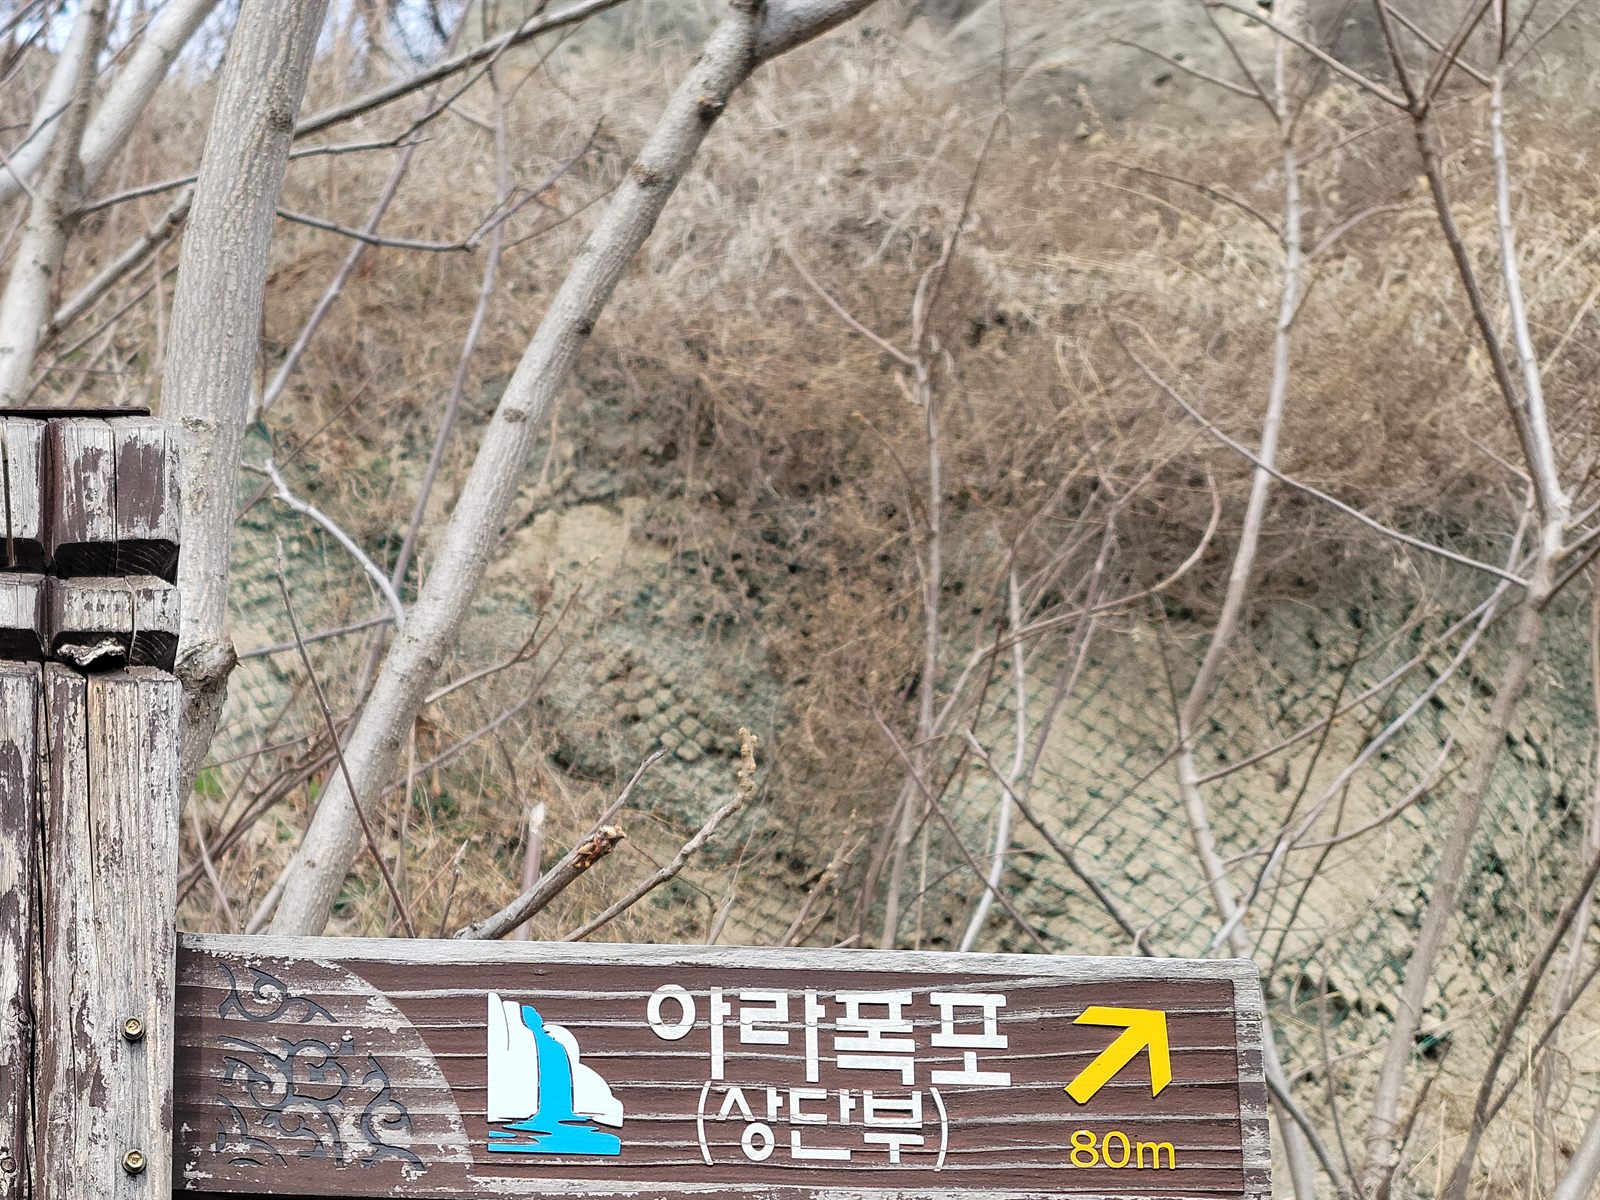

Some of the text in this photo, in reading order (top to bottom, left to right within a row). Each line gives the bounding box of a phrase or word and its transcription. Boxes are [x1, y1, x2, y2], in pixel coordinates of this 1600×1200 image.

[647, 984, 1012, 1087] 아라폭포
[696, 1080, 950, 1172] (상단부)
[1070, 1129, 1177, 1170] 80m
